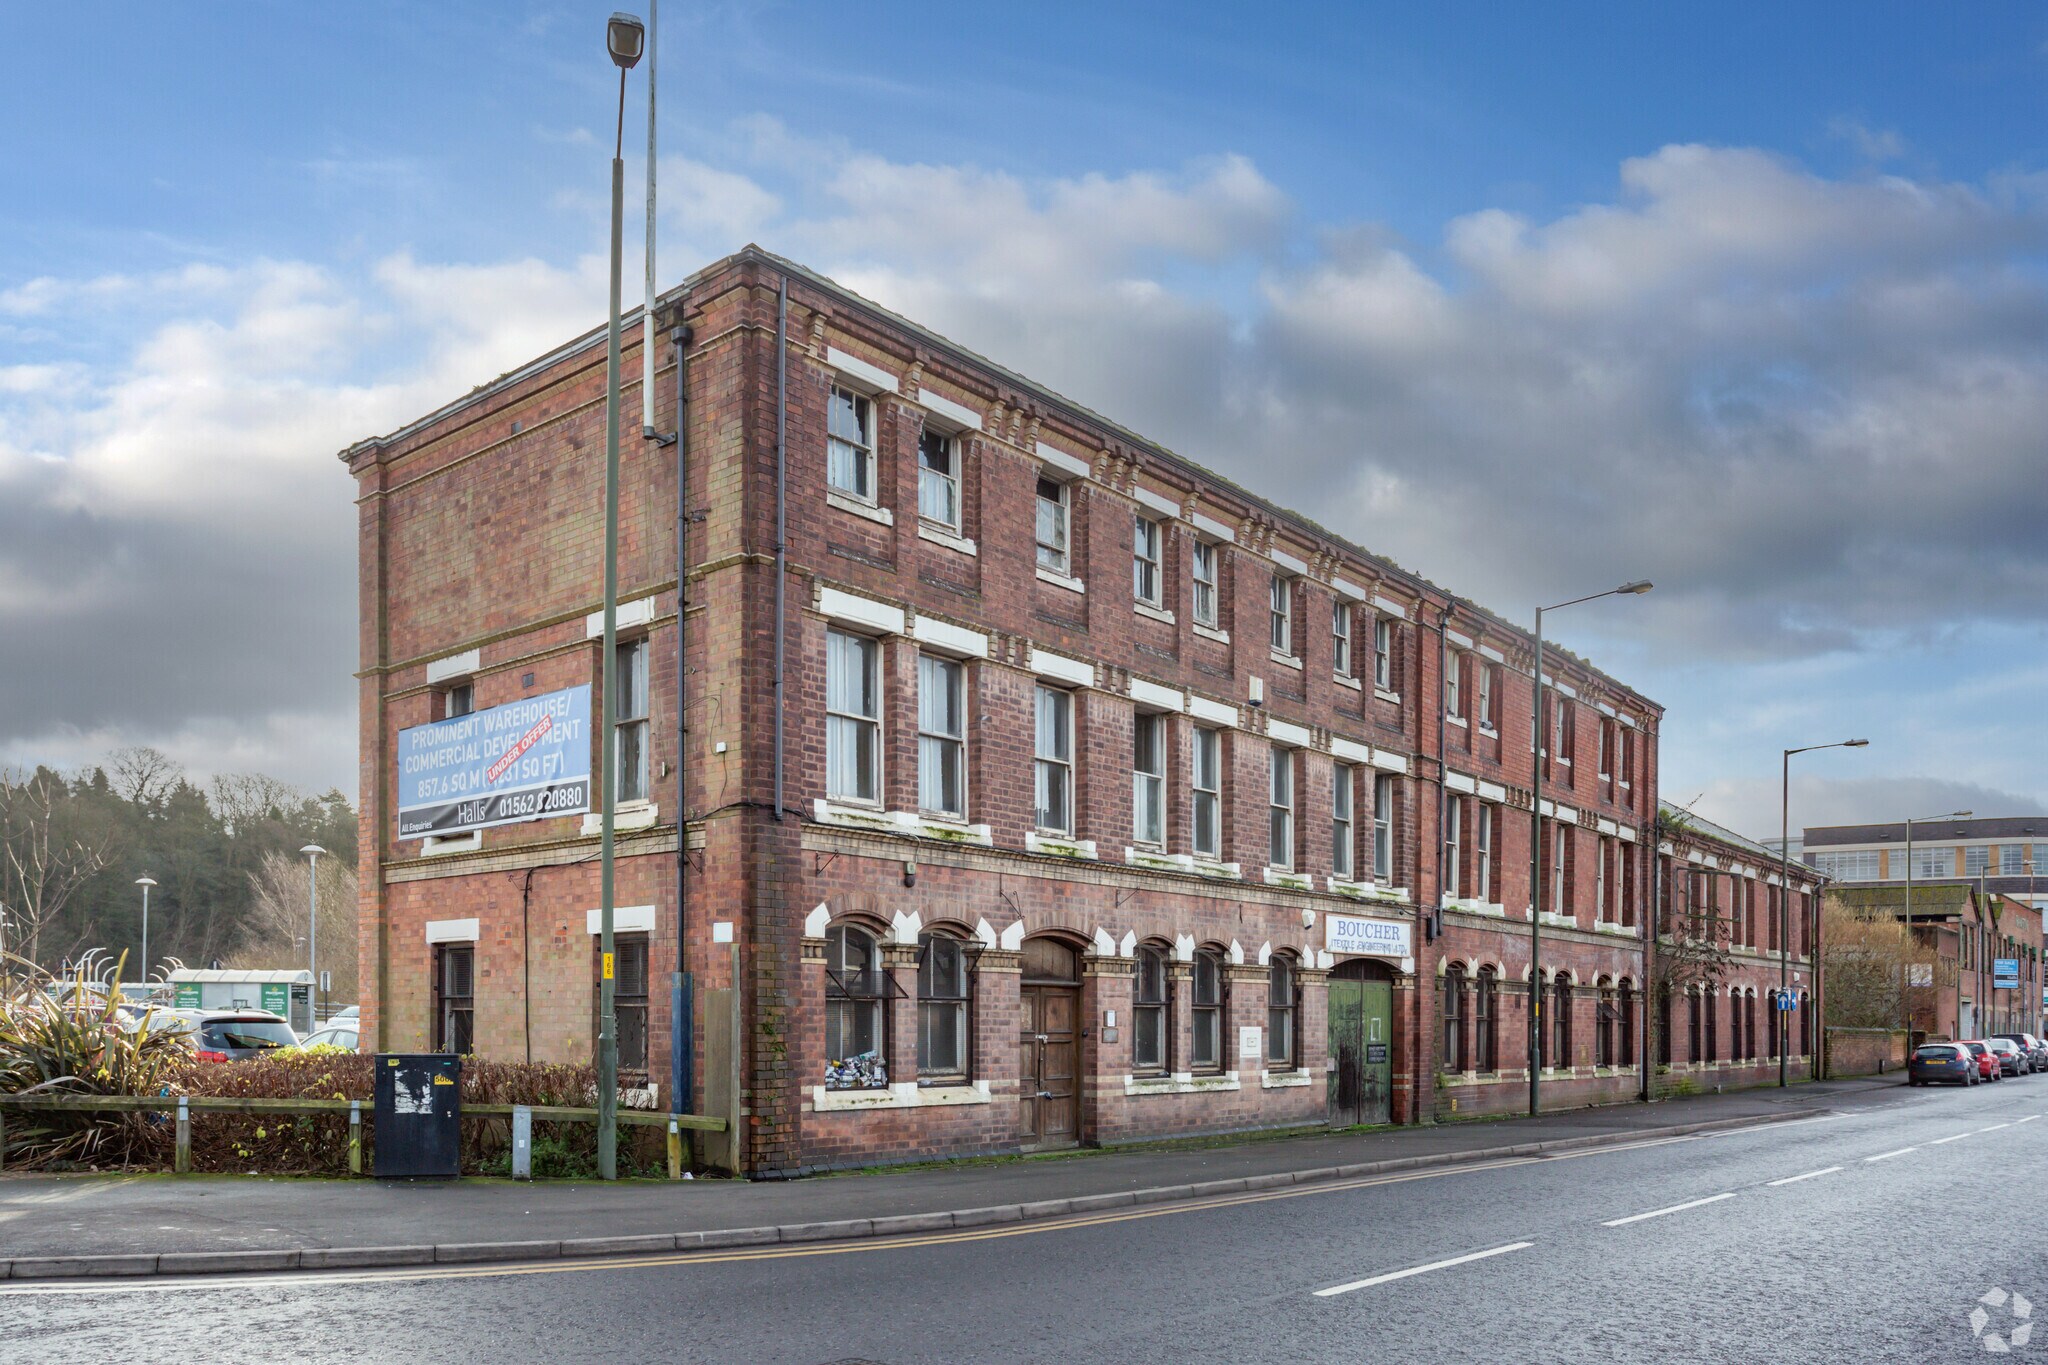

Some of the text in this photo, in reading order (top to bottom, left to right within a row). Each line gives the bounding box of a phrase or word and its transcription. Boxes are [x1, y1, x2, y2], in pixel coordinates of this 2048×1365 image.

[412, 692, 572, 750] PROMINENT WAREHOUSE/
[405, 719, 581, 774] COMMERCIAL DEVEMENT
[488, 717, 551, 780] UNDER OFFER
[418, 775, 448, 799] 857.6
[451, 772, 466, 792] SQ
[469, 768, 480, 789] M
[522, 757, 539, 779] SQ
[542, 750, 565, 775] FT)
[457, 801, 487, 824] Halls
[500, 786, 582, 817] 01562 820880
[409, 821, 433, 832] Enquiries
[1337, 920, 1400, 940] BOUCHER
